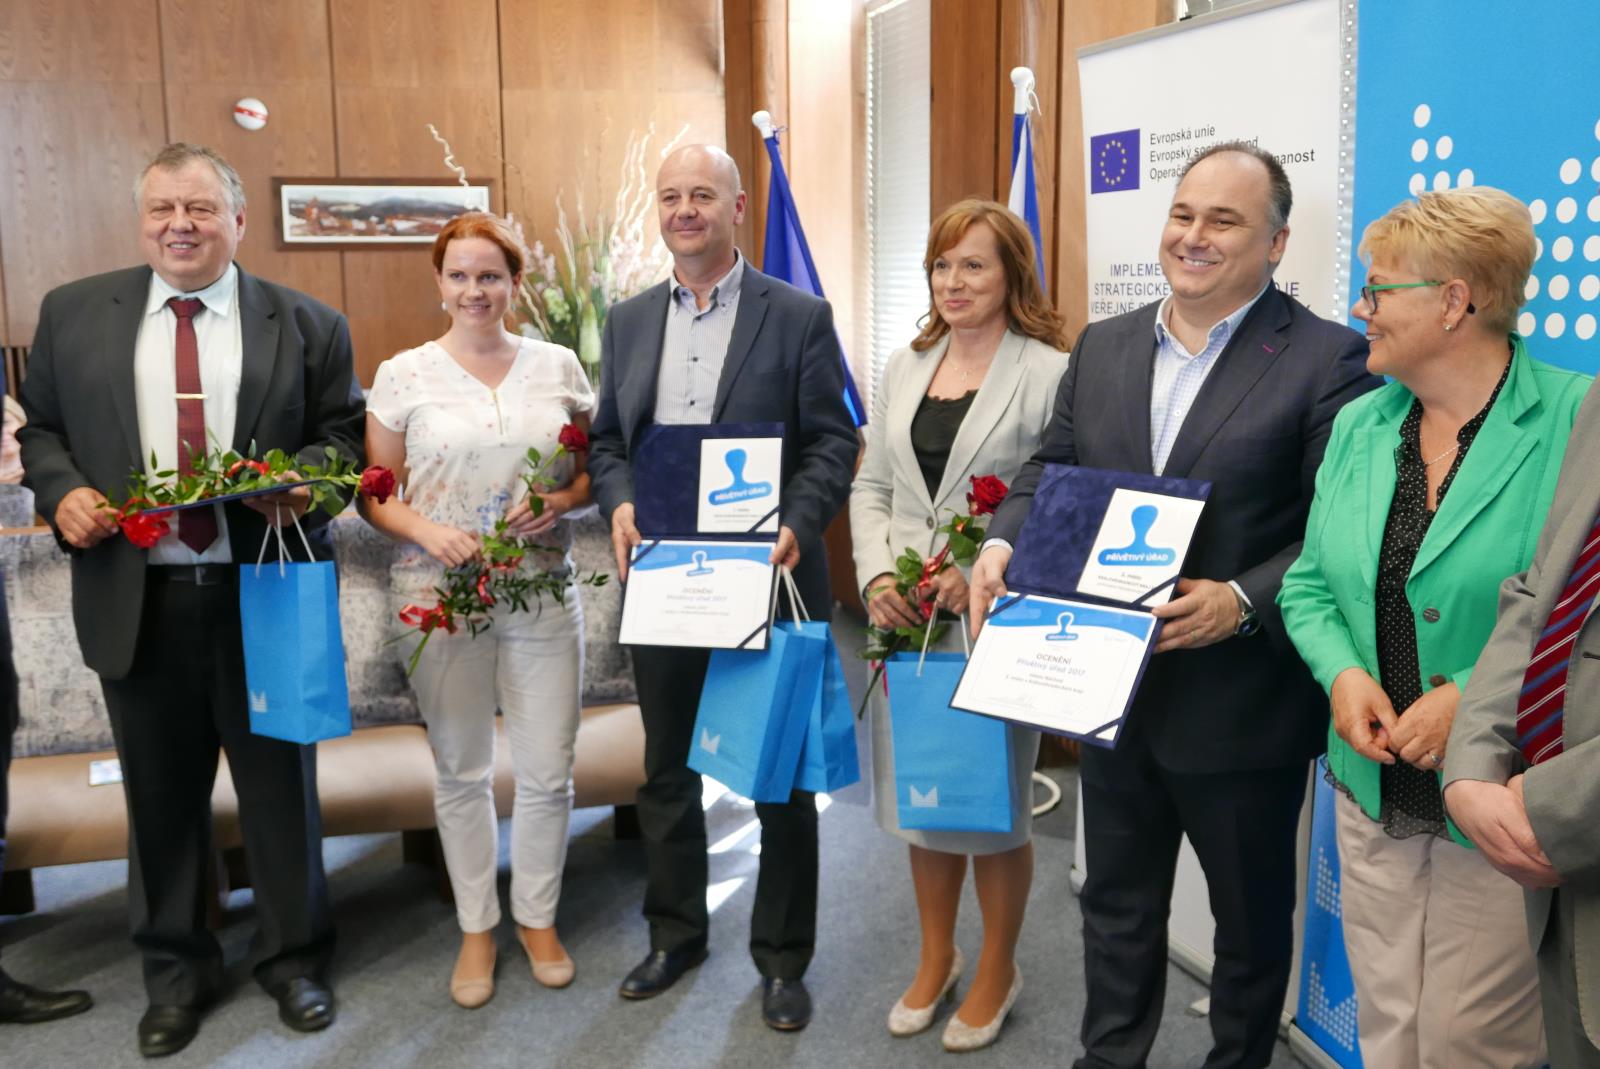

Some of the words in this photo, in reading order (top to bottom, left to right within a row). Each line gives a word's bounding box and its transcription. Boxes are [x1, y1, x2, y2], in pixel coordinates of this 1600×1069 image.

[1150, 127, 1192, 145] Evropská
[1194, 124, 1216, 139] unie
[1150, 145, 1192, 163] Evropský
[1149, 165, 1186, 182] Operač
[1110, 263, 1161, 277] IMPLEME
